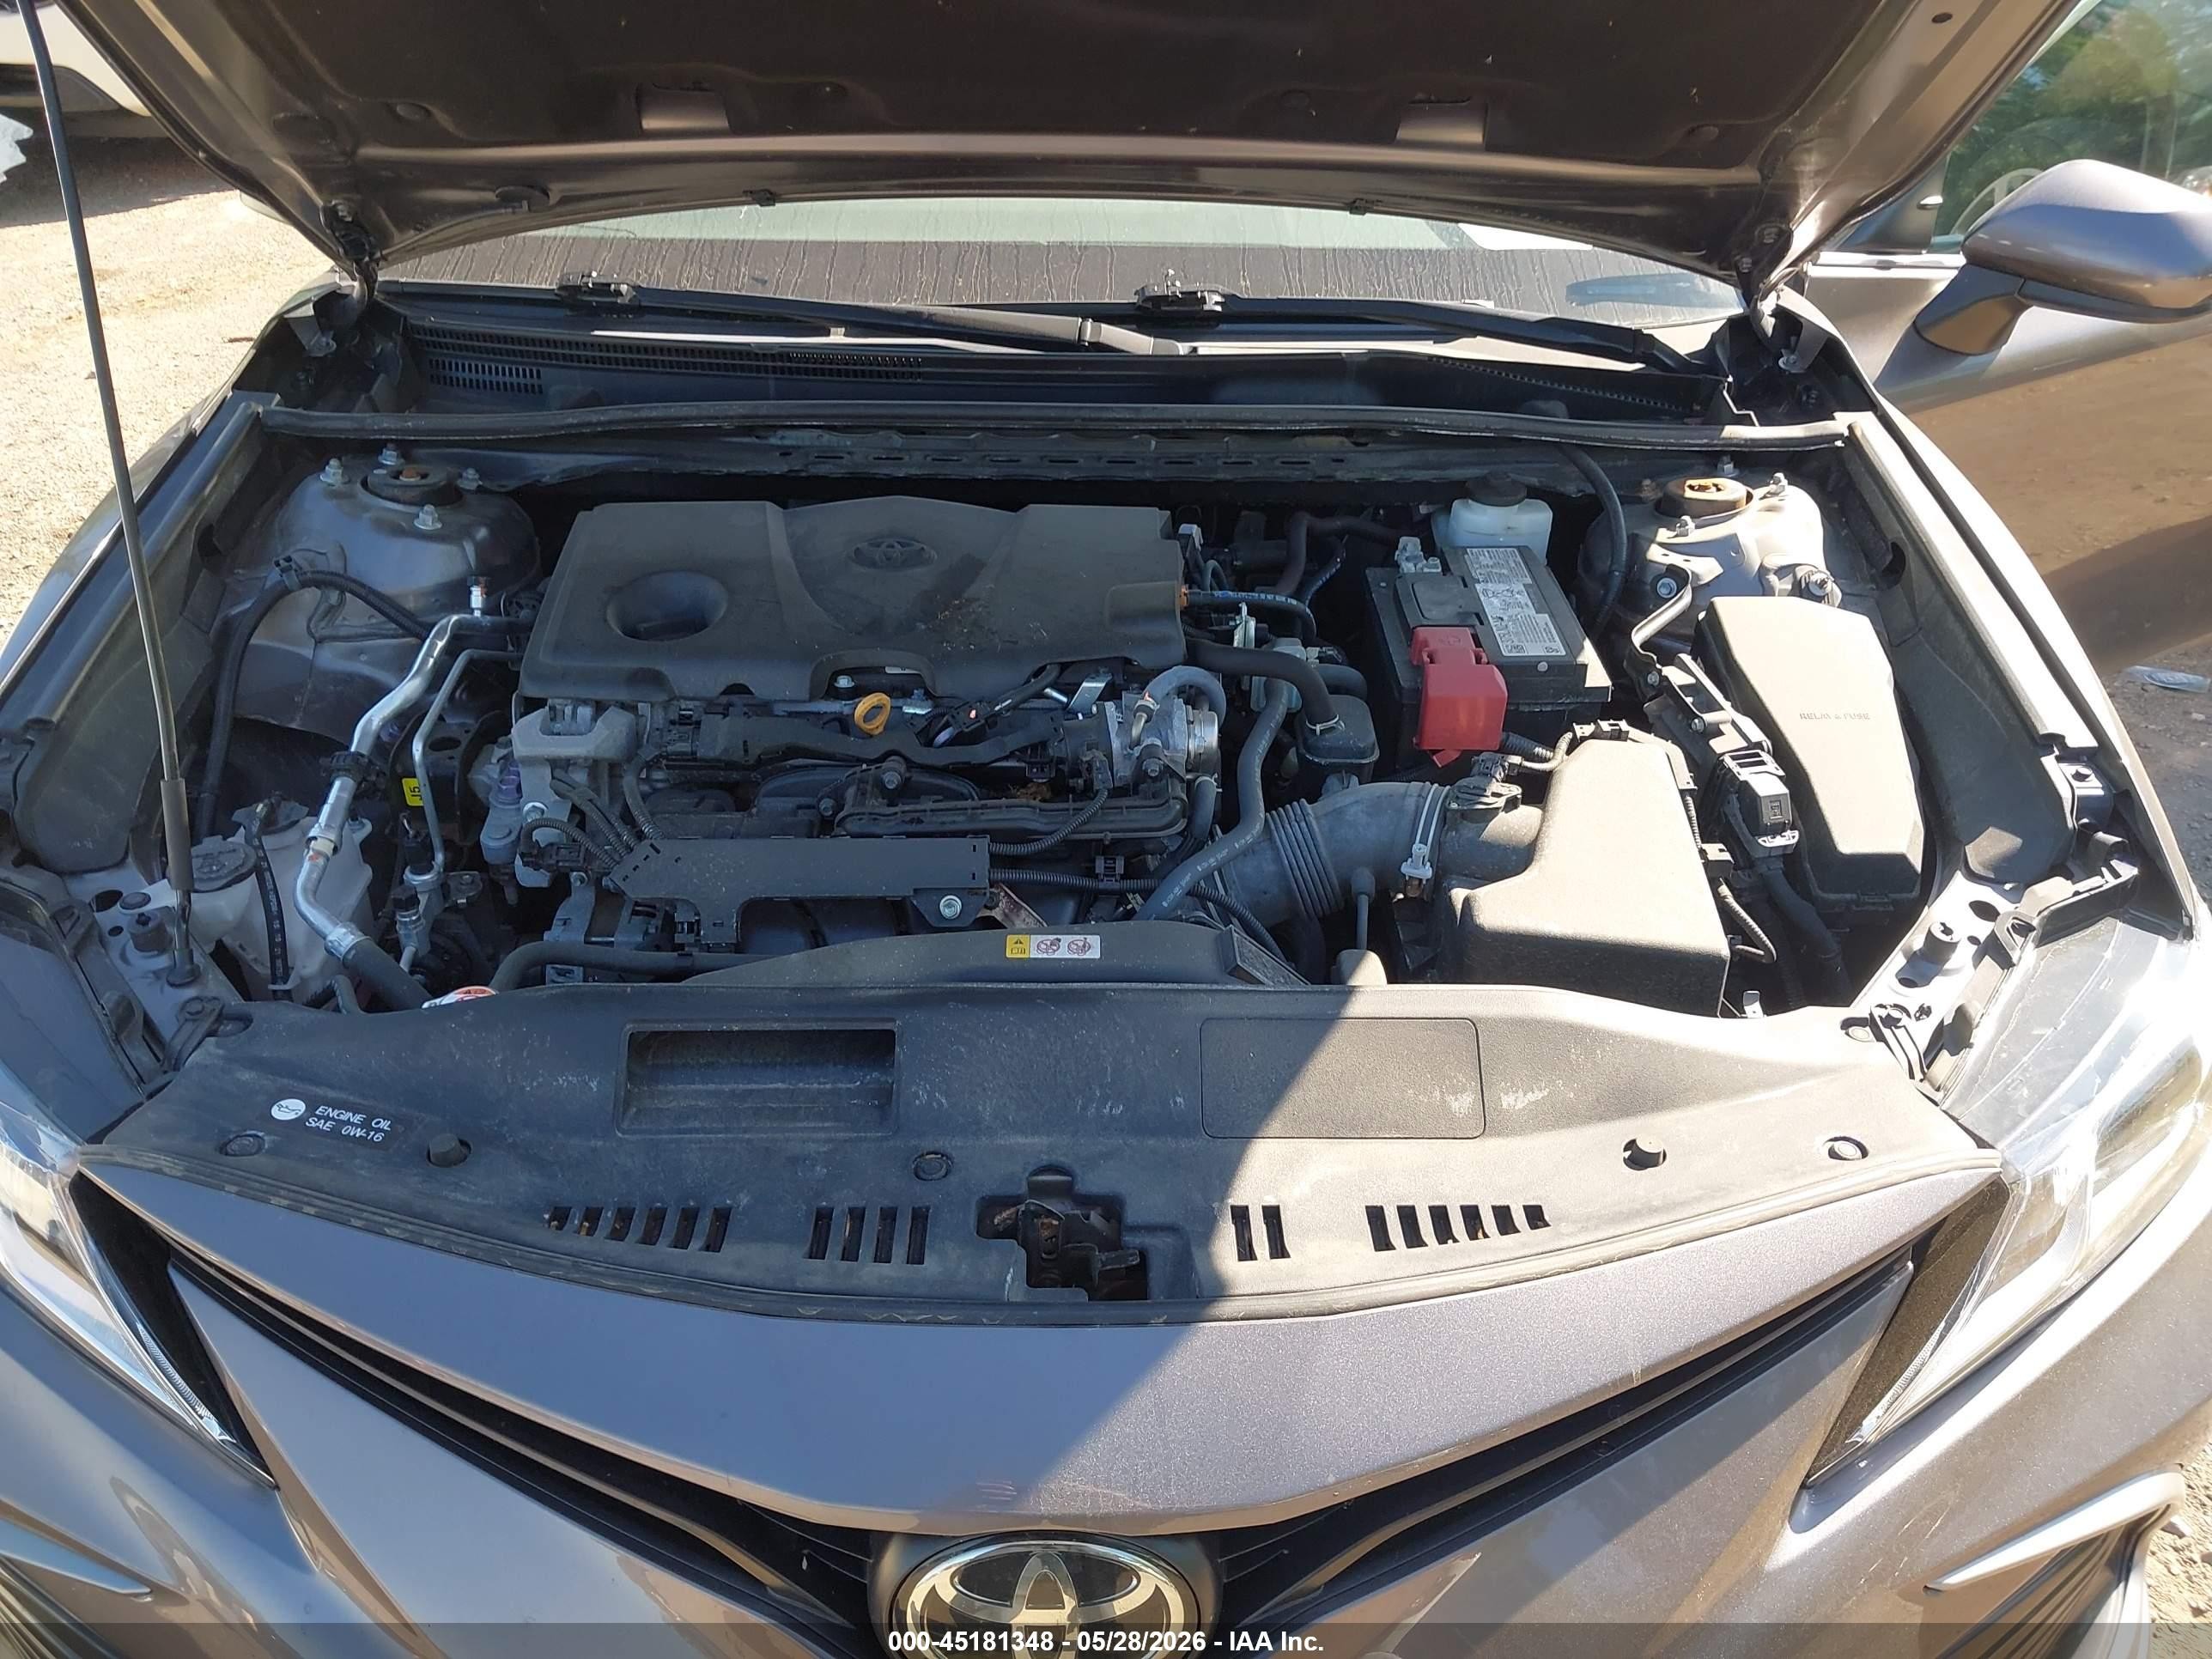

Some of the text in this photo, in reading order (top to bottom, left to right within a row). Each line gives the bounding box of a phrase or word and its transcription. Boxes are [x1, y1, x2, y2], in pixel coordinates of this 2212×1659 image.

[306, 1116, 385, 1142] SAE 0W-16
[315, 1105, 392, 1131] ENGINE OIL
